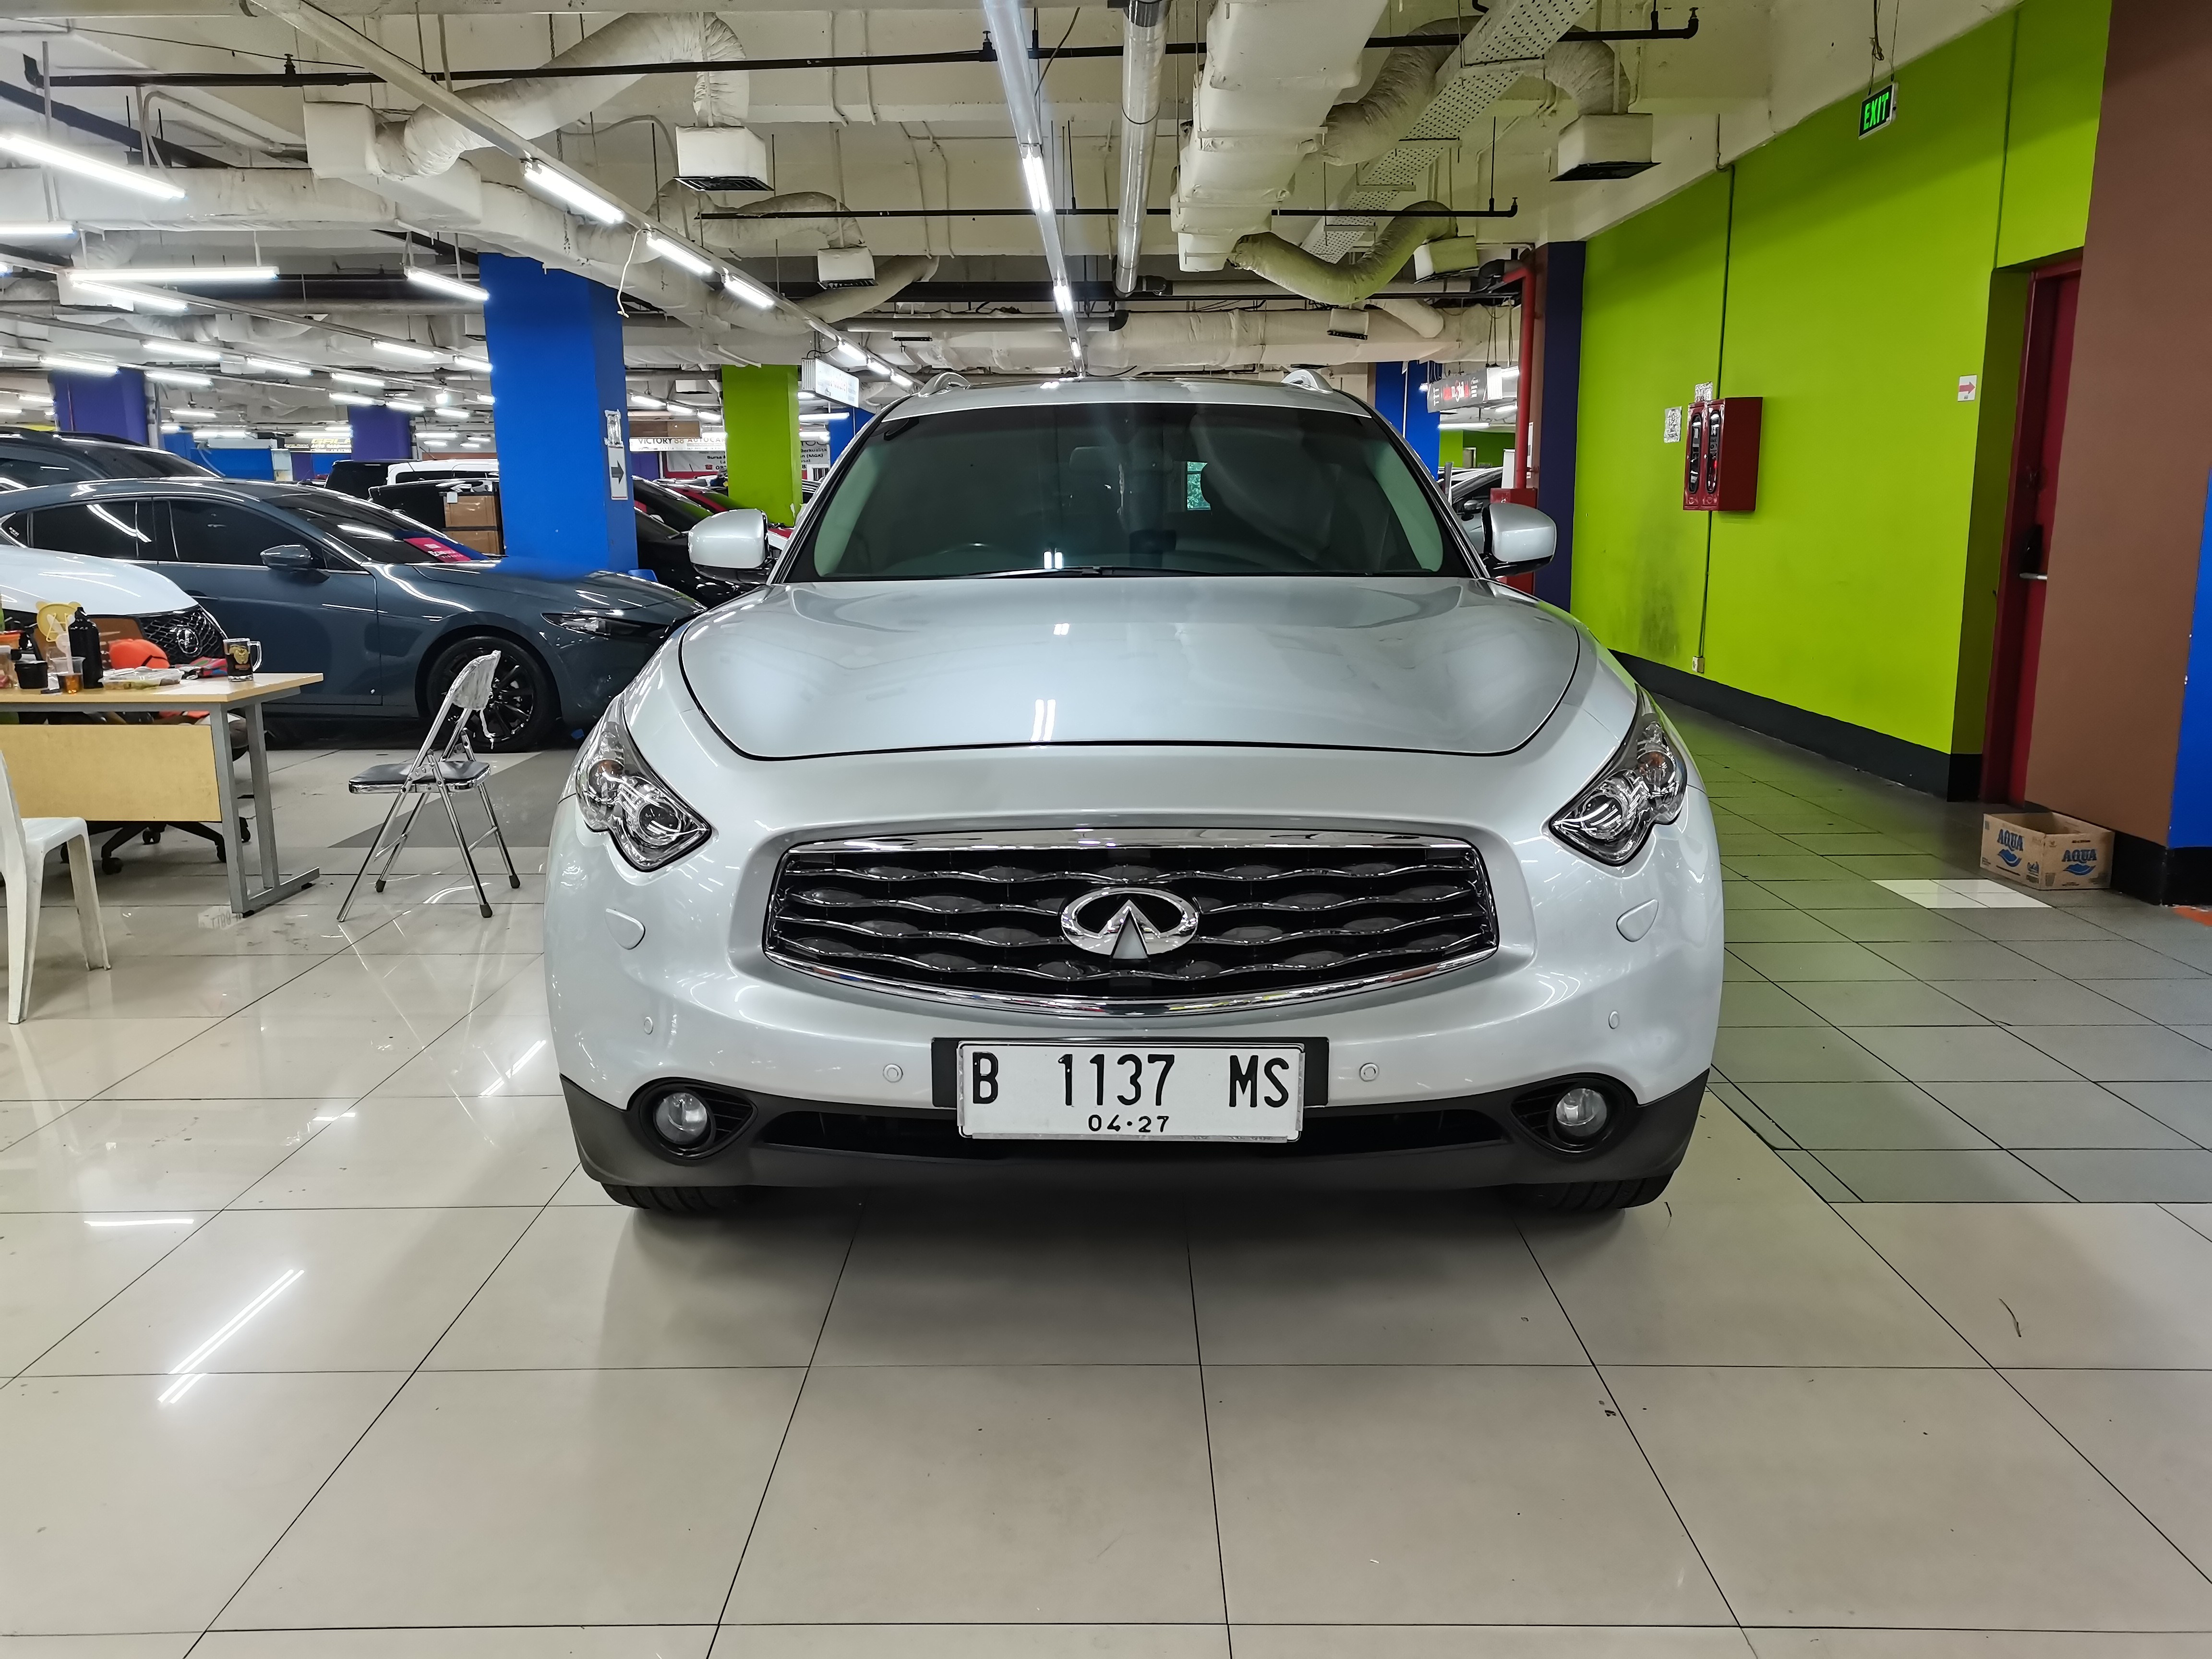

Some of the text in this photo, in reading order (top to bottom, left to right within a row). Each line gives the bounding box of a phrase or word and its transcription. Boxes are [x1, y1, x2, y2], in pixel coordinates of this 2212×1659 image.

[1863, 91, 1889, 131] EXIT
[1997, 829, 2024, 852] AQUA
[2061, 849, 2097, 864] AQUA
[973, 1052, 1289, 1107] B 1137 MS
